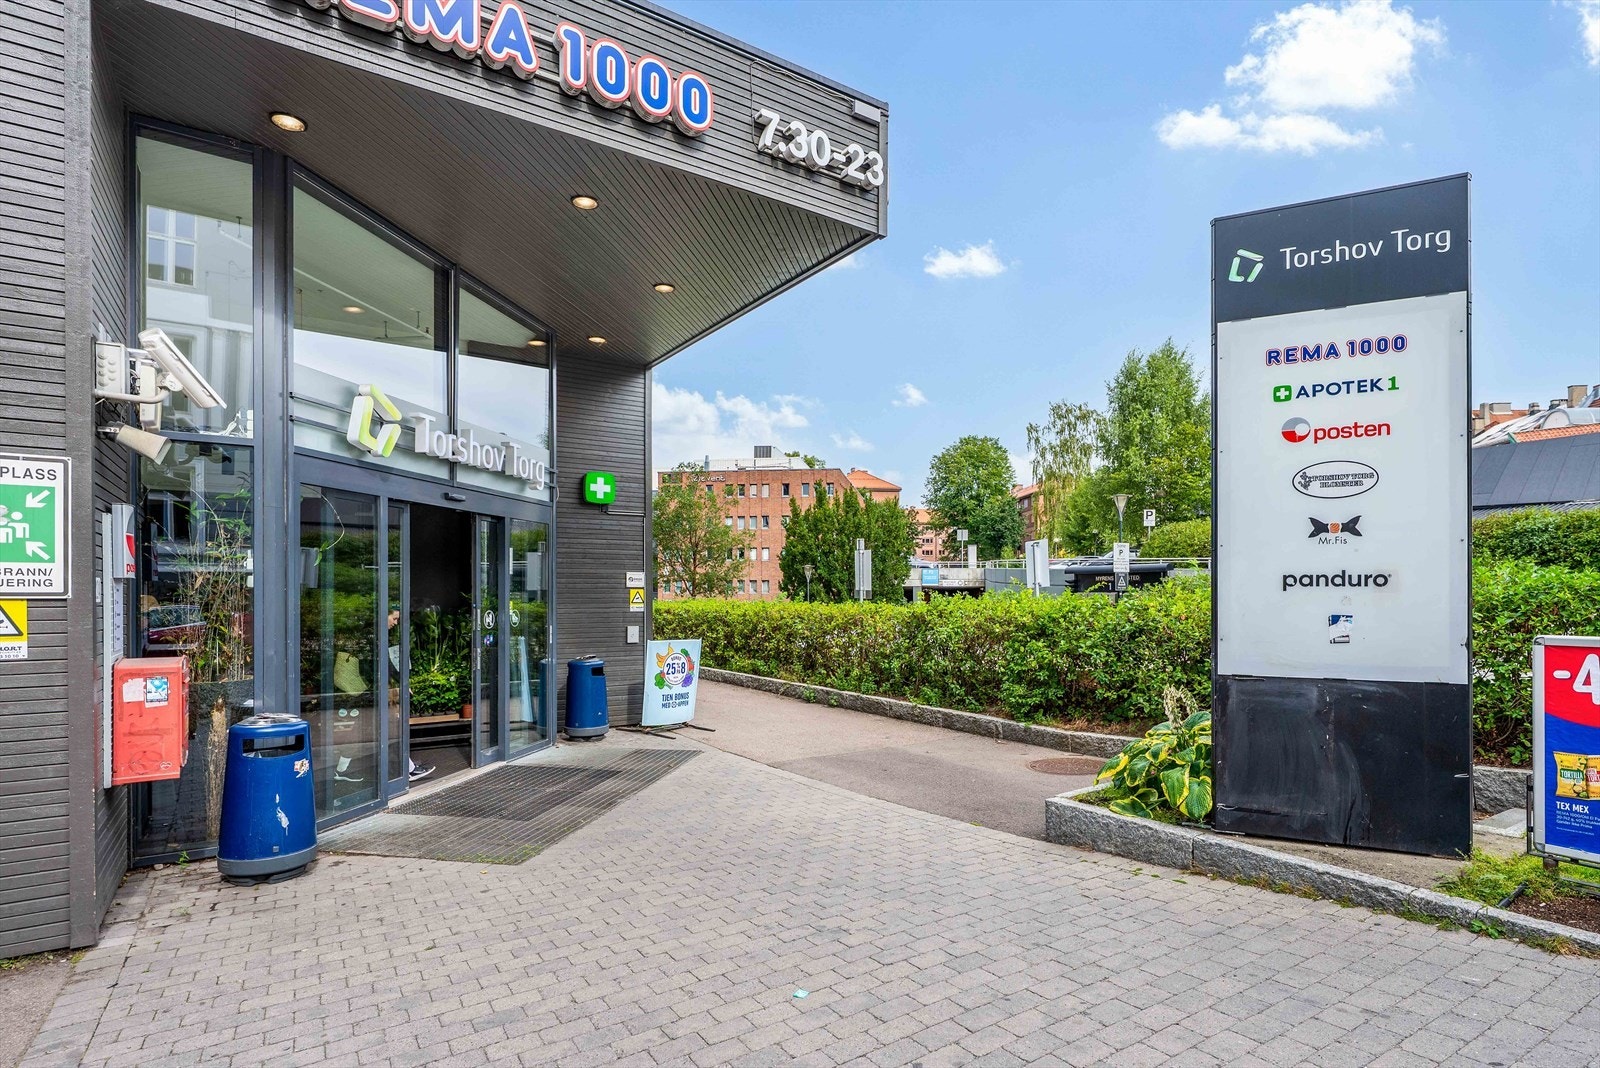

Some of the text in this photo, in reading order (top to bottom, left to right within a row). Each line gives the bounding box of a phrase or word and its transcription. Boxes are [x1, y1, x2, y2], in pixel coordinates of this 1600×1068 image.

[556, 21, 713, 136] 1000
[755, 108, 884, 187] 7.30-23
[1280, 228, 1451, 270] Torshov Torg
[1266, 334, 1407, 366] REMA 1000
[1295, 375, 1399, 399] APOTEK 1
[1313, 421, 1391, 444] posten
[410, 412, 545, 491] Torshov Torg
[1311, 472, 1375, 482] TORSHOV TORG
[1145, 511, 1153, 519] P
[1318, 536, 1348, 545] Mr.Fis
[1282, 569, 1389, 592] panduro
[667, 663, 676, 675] 25
[681, 662, 685, 674] 8
[1556, 801, 1589, 814] TEX MEX
